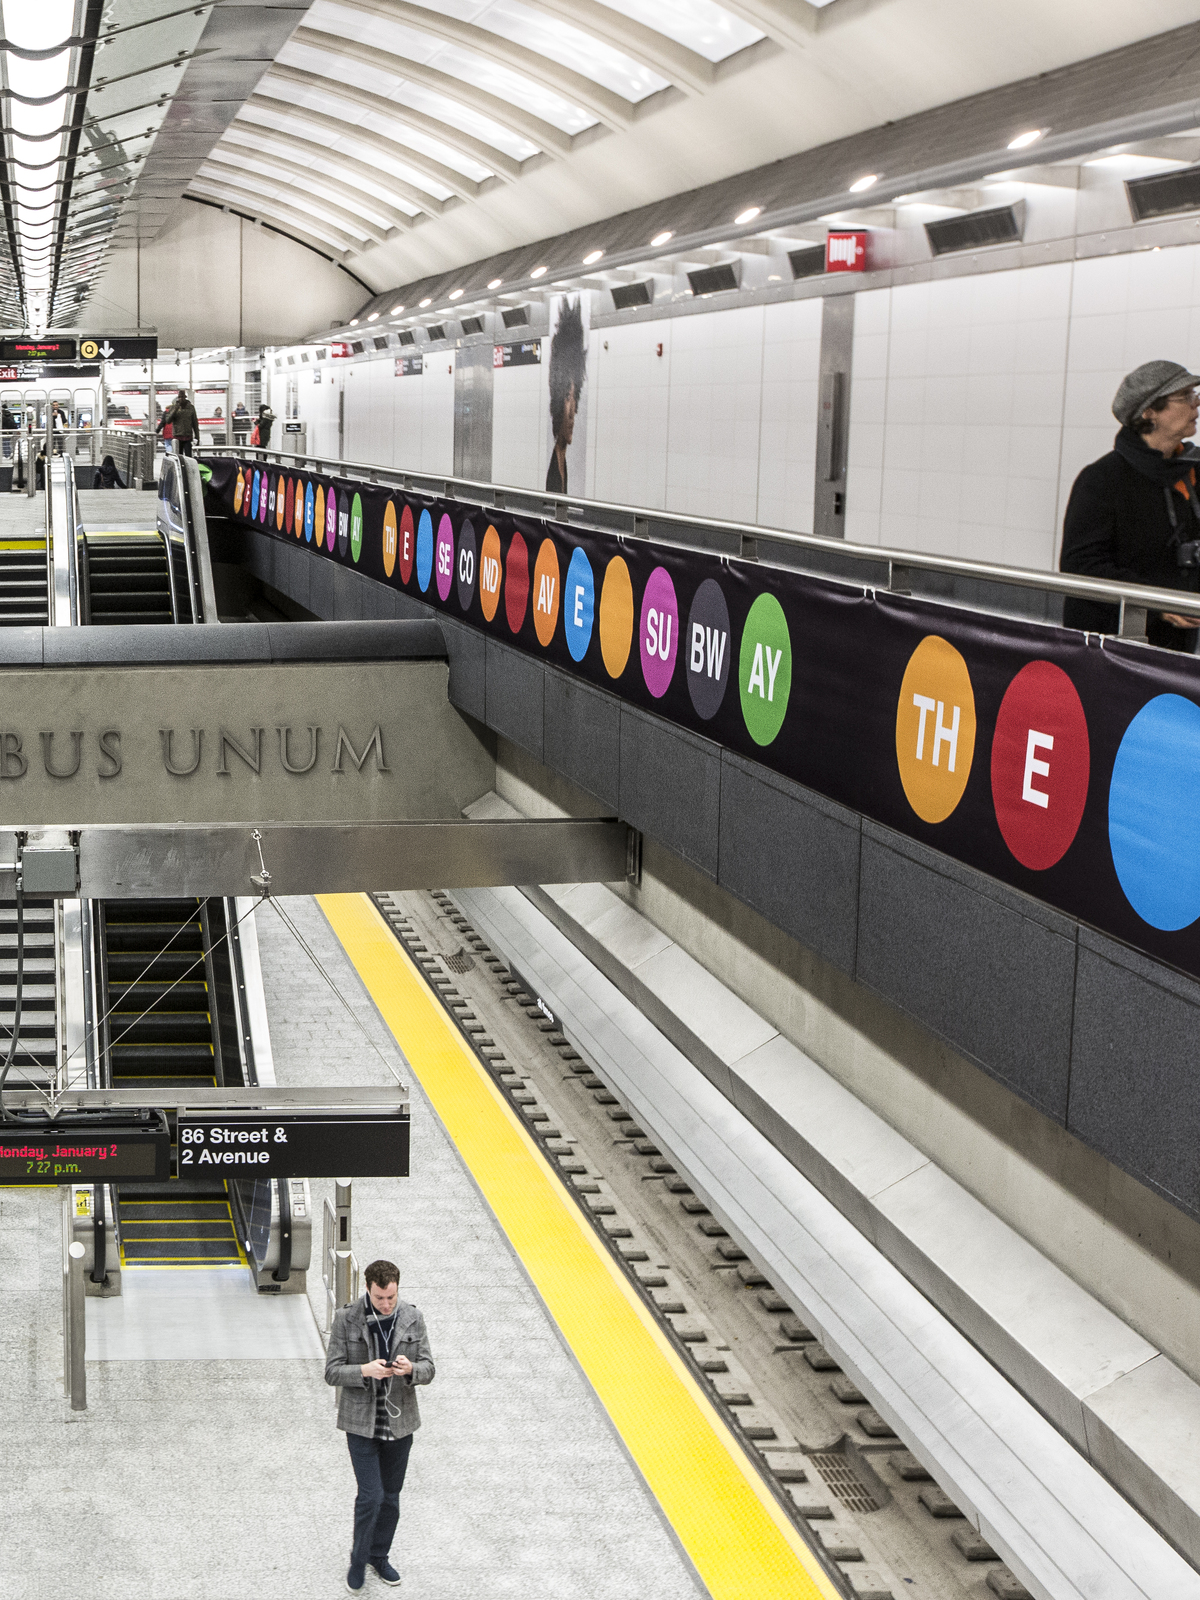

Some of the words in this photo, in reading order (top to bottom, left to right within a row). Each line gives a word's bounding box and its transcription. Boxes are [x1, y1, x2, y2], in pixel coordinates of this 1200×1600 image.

[85, 346, 94, 355] Q
[307, 502, 311, 524] E
[328, 508, 335, 533] SU
[339, 512, 348, 537] BW
[352, 516, 361, 542] AY
[385, 526, 394, 555] TH
[404, 531, 409, 560] E
[438, 542, 450, 576] SE
[460, 549, 473, 584] CO
[483, 556, 498, 593] ND
[537, 574, 555, 615] AV
[574, 585, 584, 628] E
[645, 608, 671, 661] SU
[690, 622, 727, 681] BW
[747, 643, 782, 701] AY
[158, 724, 392, 775] UNUM
[913, 693, 960, 772] TH
[1022, 729, 1054, 809] E
[182, 1129, 204, 1144] 86
[210, 1128, 268, 1143] Street
[274, 1127, 288, 1143] &
[52, 1145, 107, 1160] January
[110, 1144, 117, 1157] 2
[182, 1150, 193, 1164] 2
[198, 1149, 270, 1164] Avenue
[54, 1162, 81, 1175] p.m.
